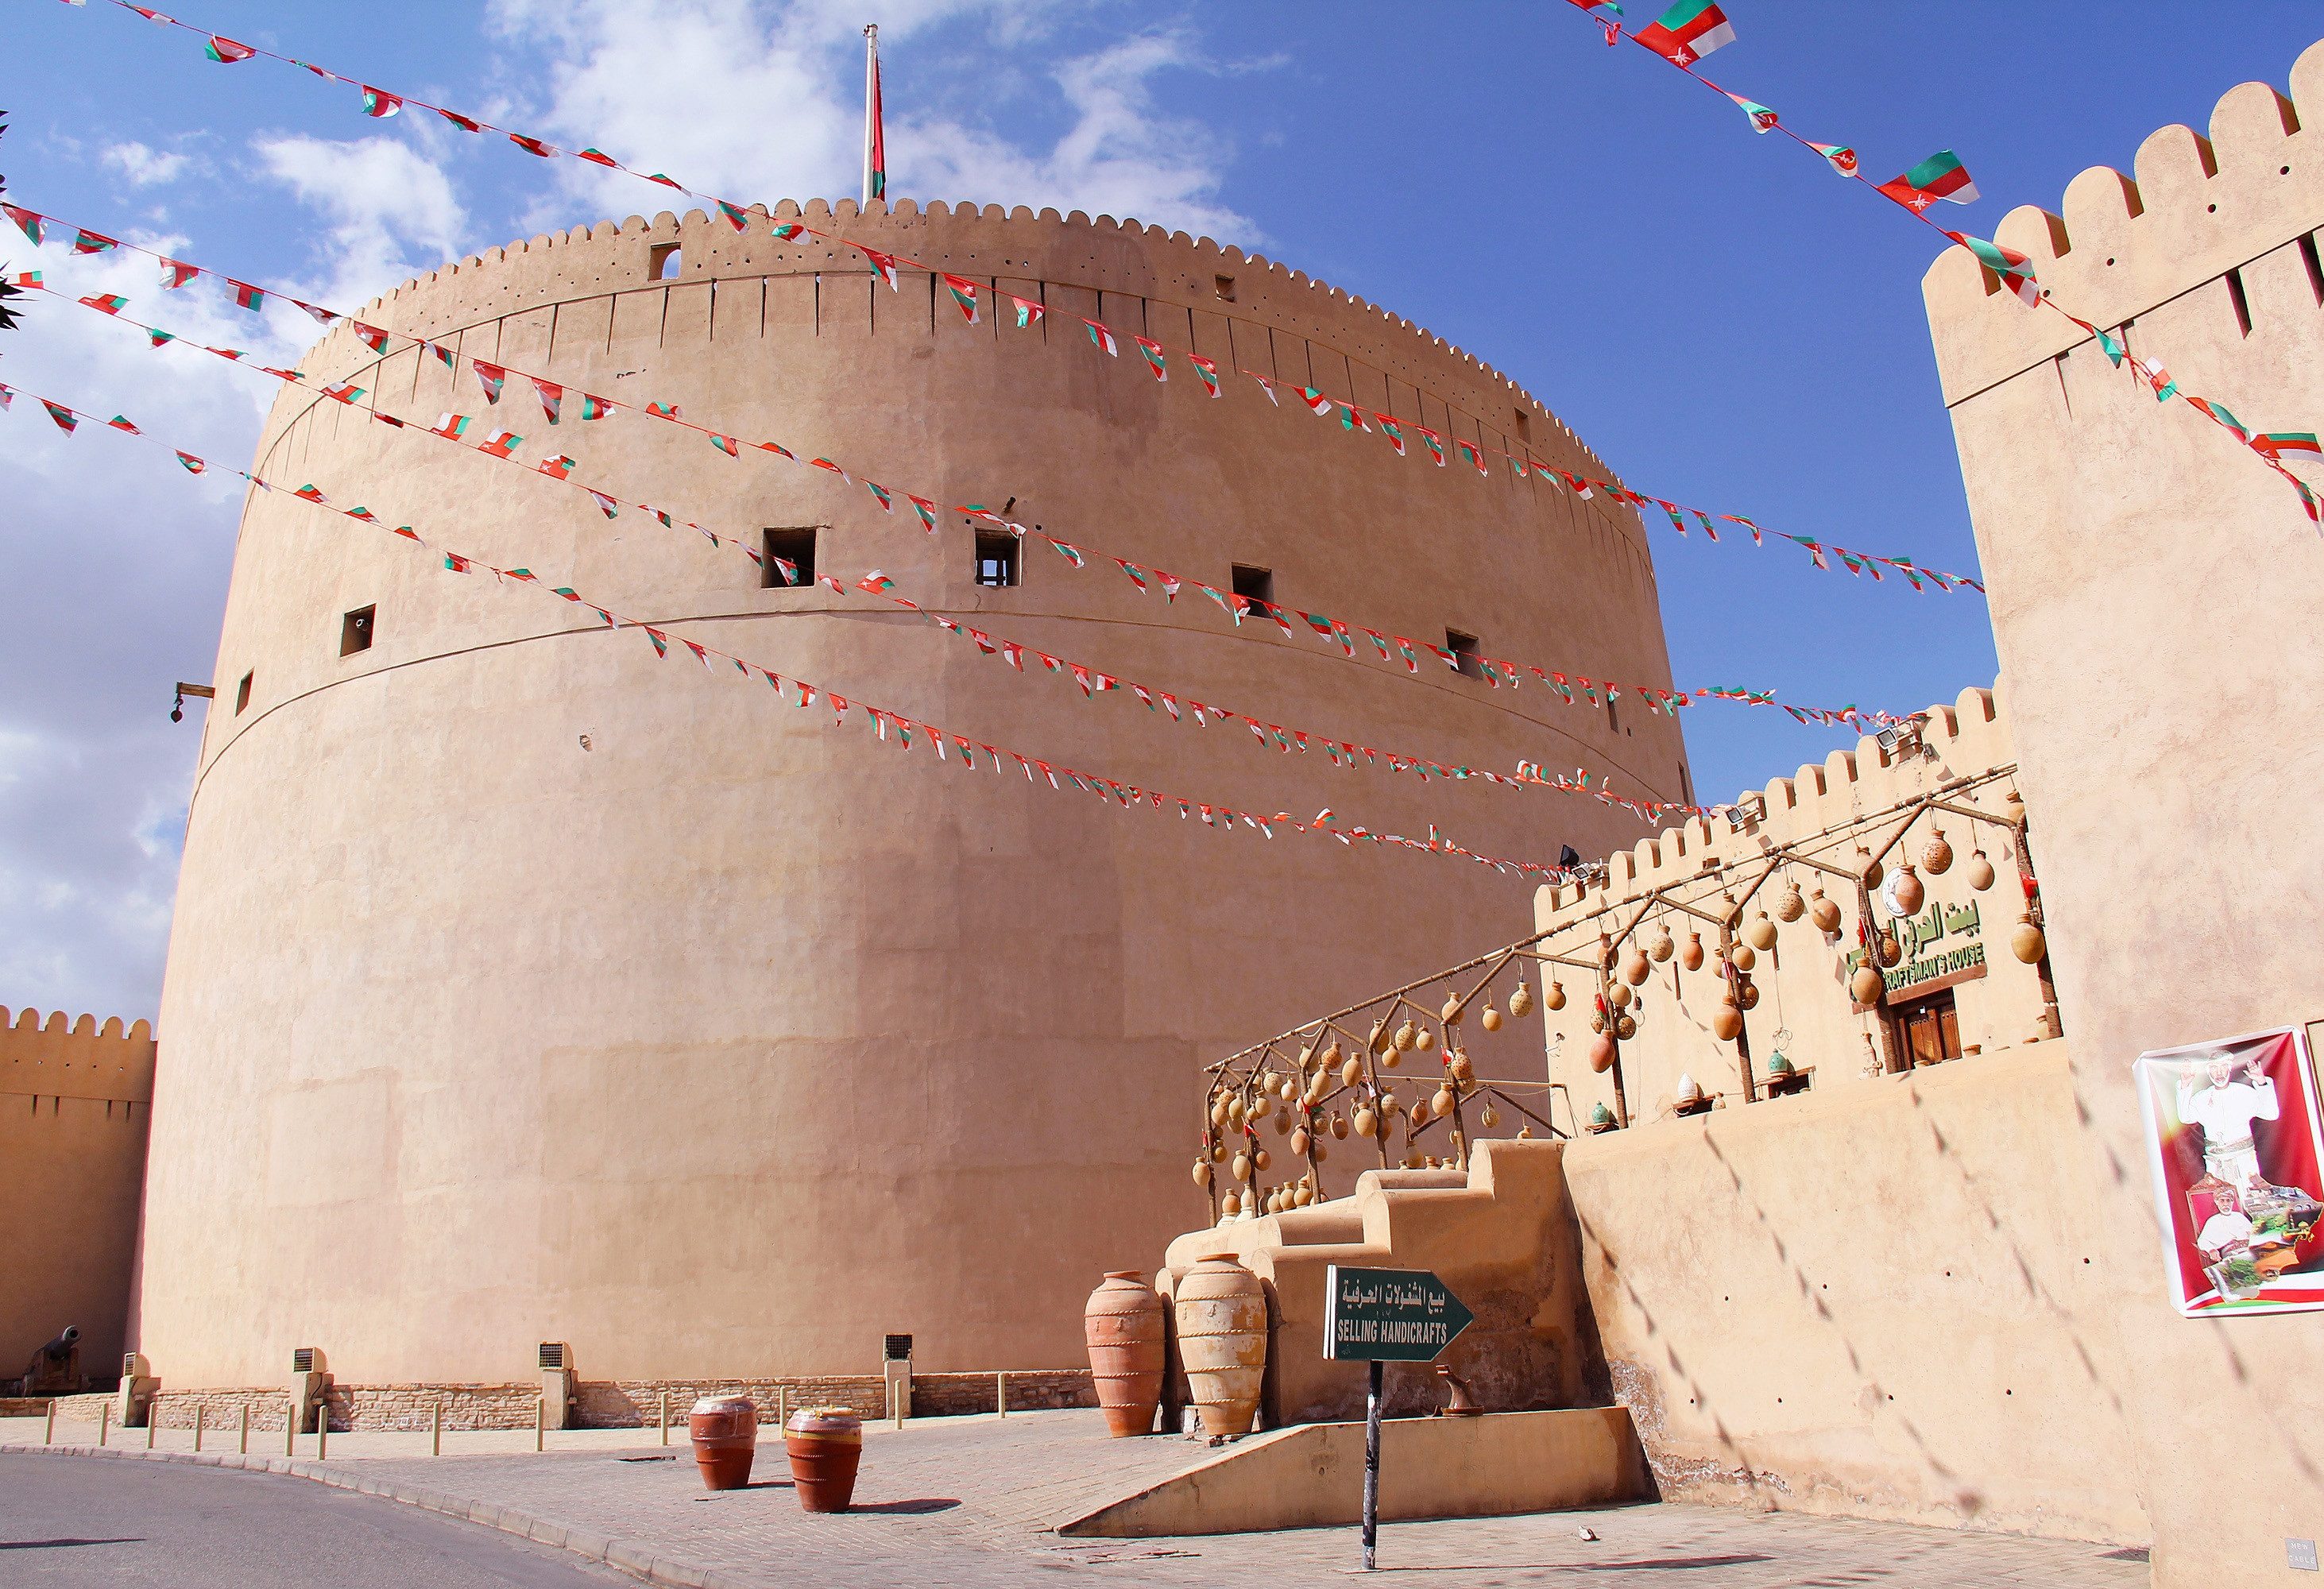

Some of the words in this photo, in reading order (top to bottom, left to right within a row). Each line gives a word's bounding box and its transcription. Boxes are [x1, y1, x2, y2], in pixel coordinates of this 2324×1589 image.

[1945, 899, 1981, 938] بيت
[1883, 954, 1947, 992] RAFTSMAN'S
[1949, 942, 1986, 971] HOUSE
[1342, 1278, 1382, 1309] الحرفية
[1385, 1281, 1426, 1310] المشغولات
[1428, 1291, 1445, 1315] بيع
[1337, 1319, 1378, 1343] SELLING
[1381, 1320, 1448, 1344] HANDICRAFTS
[2288, 1555, 2314, 1564] CABLE
